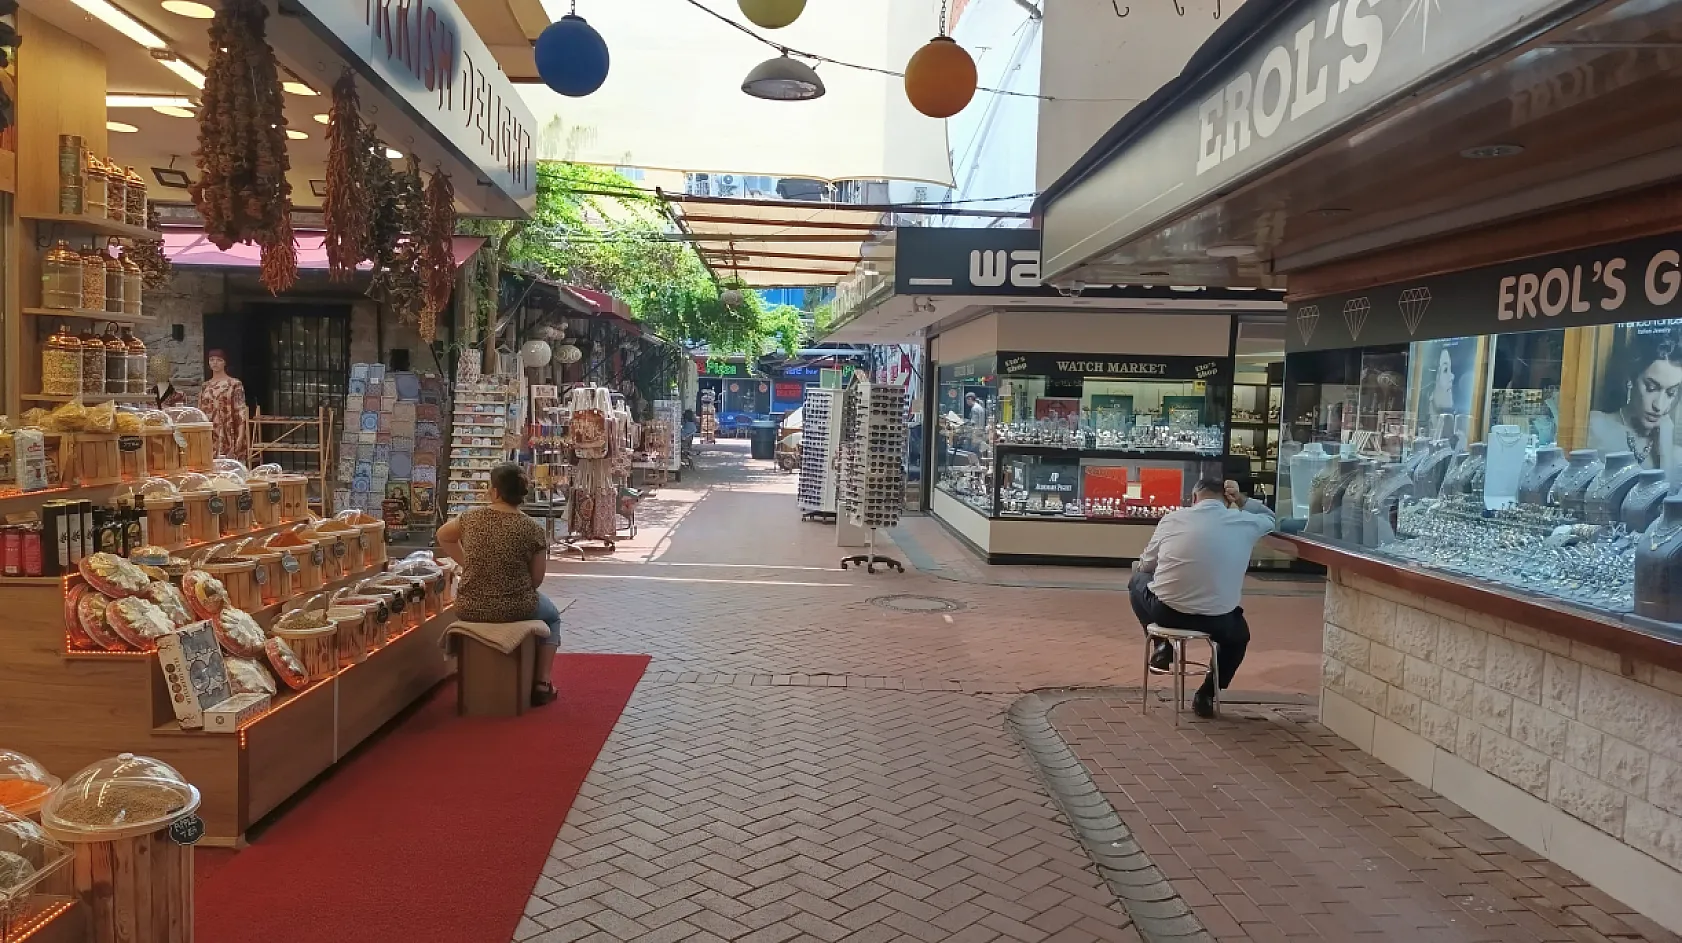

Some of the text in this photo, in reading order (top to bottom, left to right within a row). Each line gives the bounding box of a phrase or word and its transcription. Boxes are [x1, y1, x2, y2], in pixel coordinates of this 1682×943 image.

[365, 0, 531, 191] RKISH DELIGHT
[1196, 0, 1384, 176] EROL'S
[1497, 257, 1627, 321] EROL'S
[1056, 361, 1167, 374] WATCH MARKET
